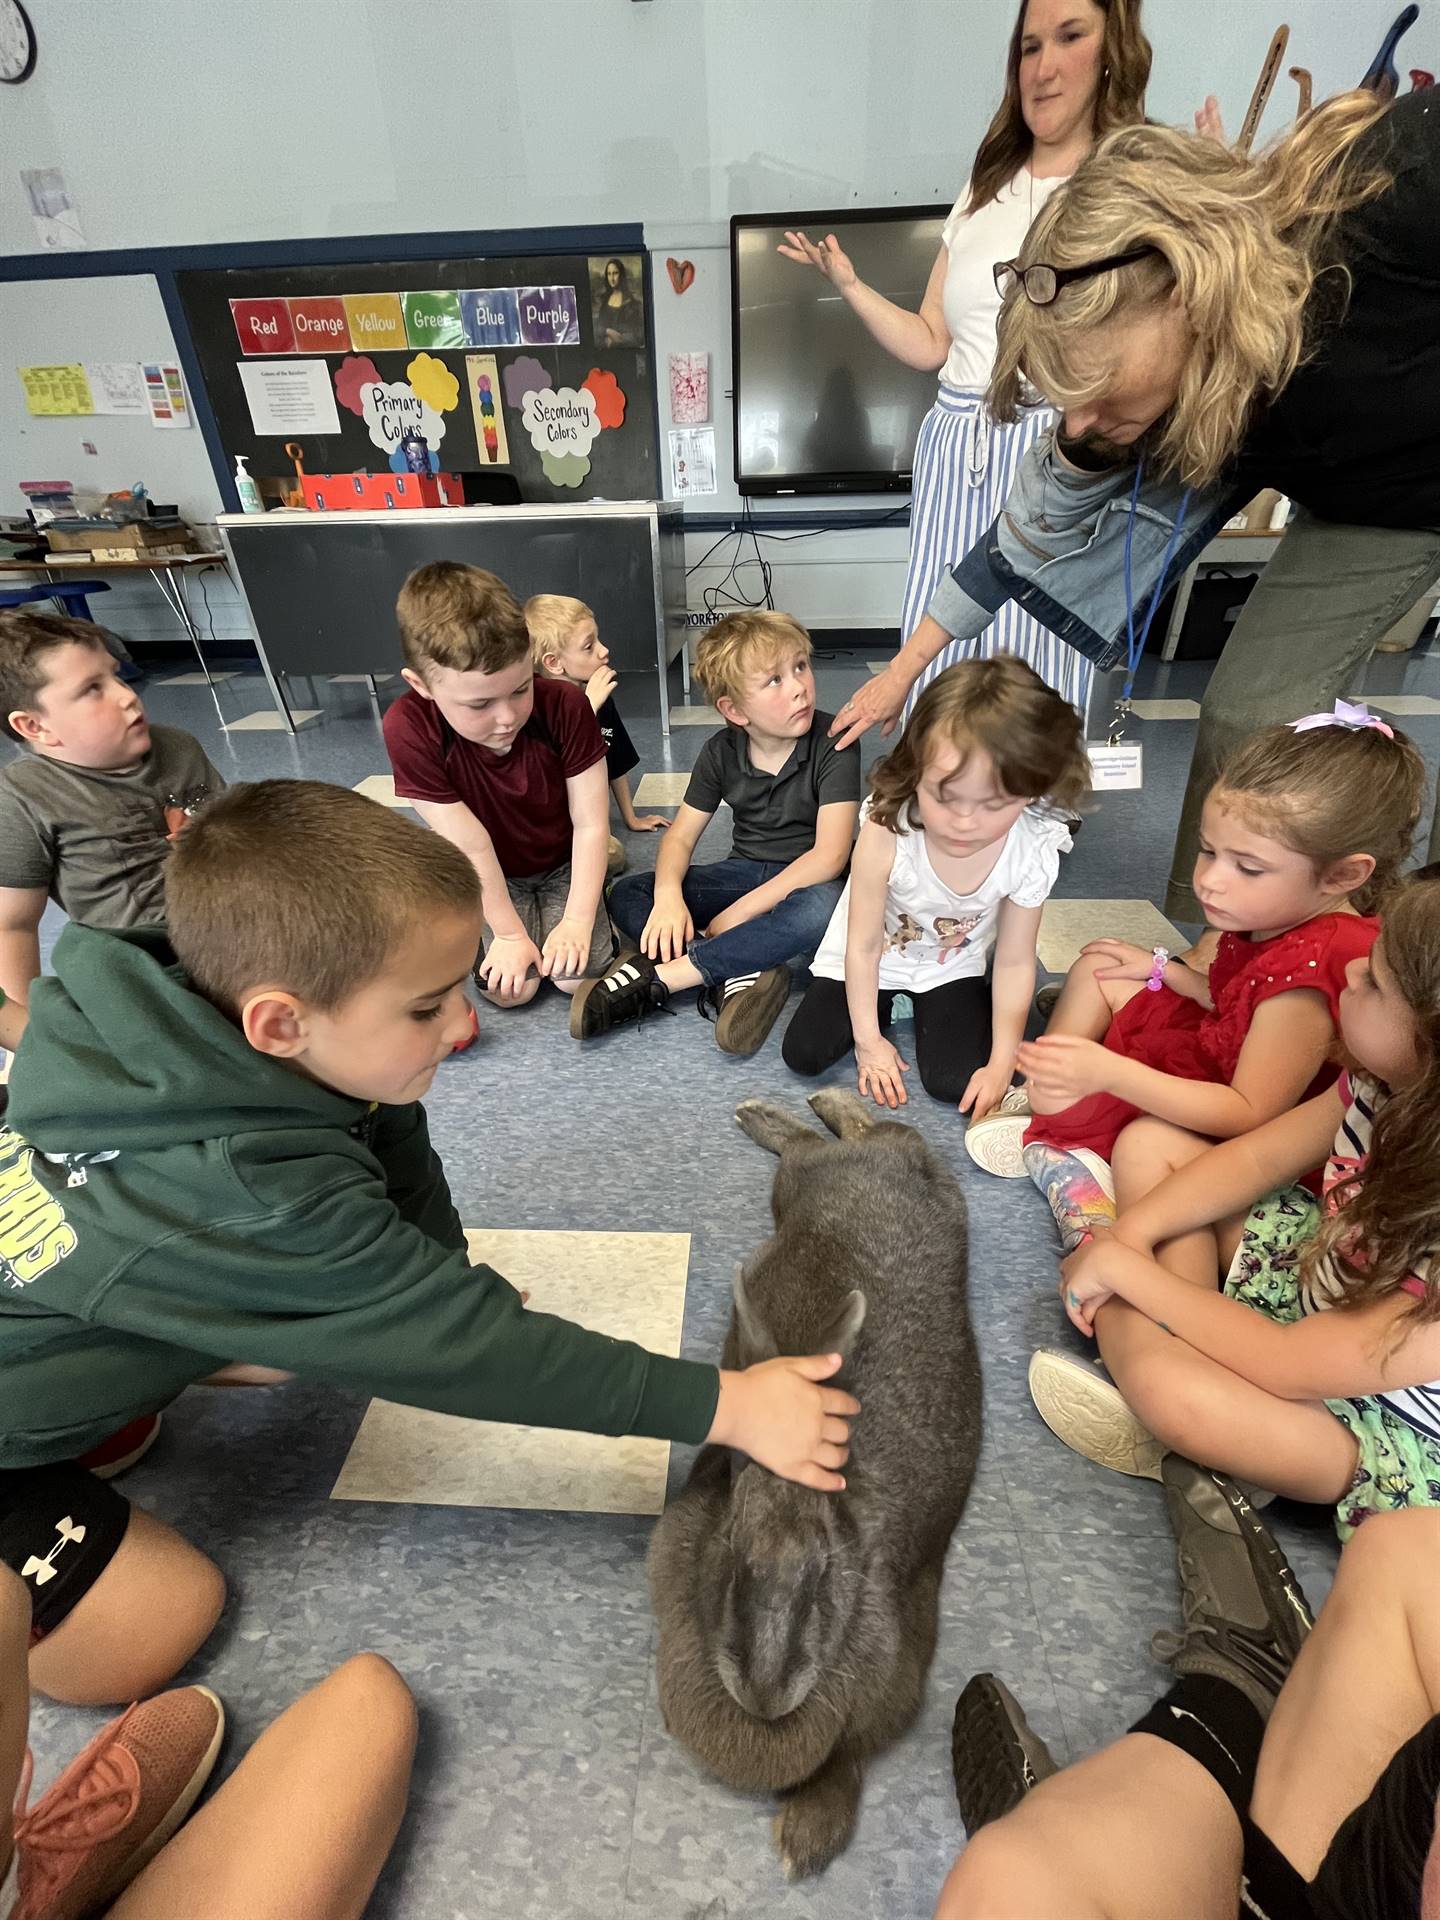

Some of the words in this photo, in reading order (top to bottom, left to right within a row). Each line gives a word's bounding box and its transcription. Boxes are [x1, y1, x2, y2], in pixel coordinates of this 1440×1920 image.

[250, 316, 278, 335] Red
[296, 313, 344, 336] Orange
[356, 312, 396, 332] Yellow
[476, 307, 505, 326] Blue
[526, 304, 570, 330] Purple
[372, 387, 423, 419] Primary
[533, 399, 590, 428] Secondary
[381, 415, 422, 441] Colors
[547, 423, 577, 442] Colors
[686, 612, 729, 626] YORKTO
